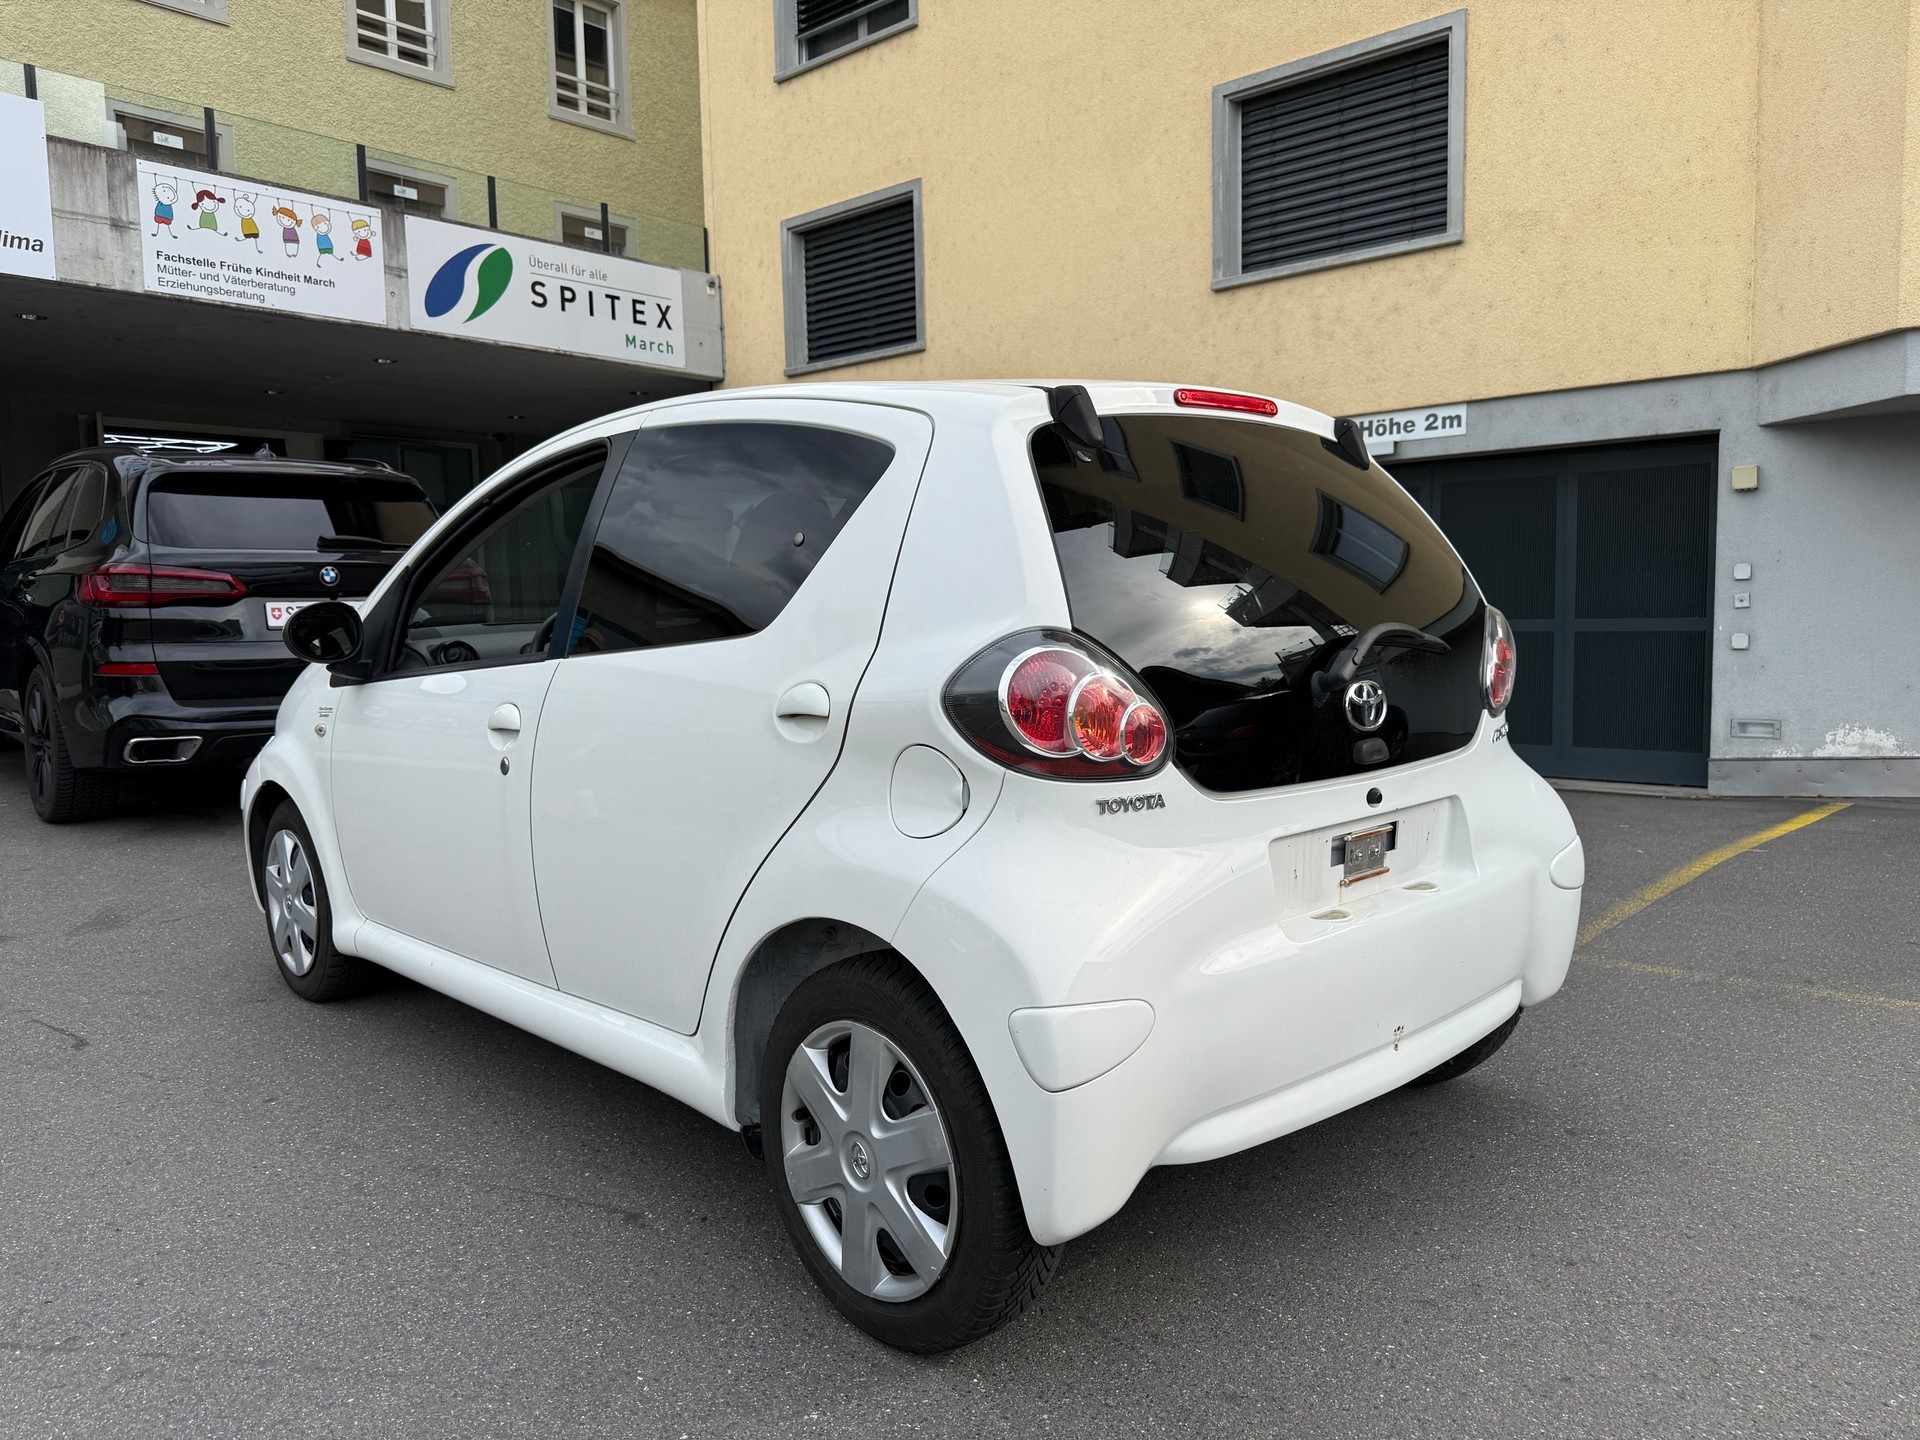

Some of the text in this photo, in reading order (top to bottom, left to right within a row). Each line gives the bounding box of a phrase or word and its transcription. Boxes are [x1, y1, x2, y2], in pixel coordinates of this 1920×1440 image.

[156, 250, 336, 289] Fachstelle Frühe Kindheit March
[156, 263, 296, 296] Mütter- und Väterberatung
[528, 254, 608, 282] Überall für alle
[157, 276, 266, 303] Erziehungsberatung
[530, 280, 673, 331] SPITEX
[625, 334, 674, 355] March
[1359, 413, 1462, 438] Höhe 2m
[1095, 791, 1166, 816] TOYOTA
